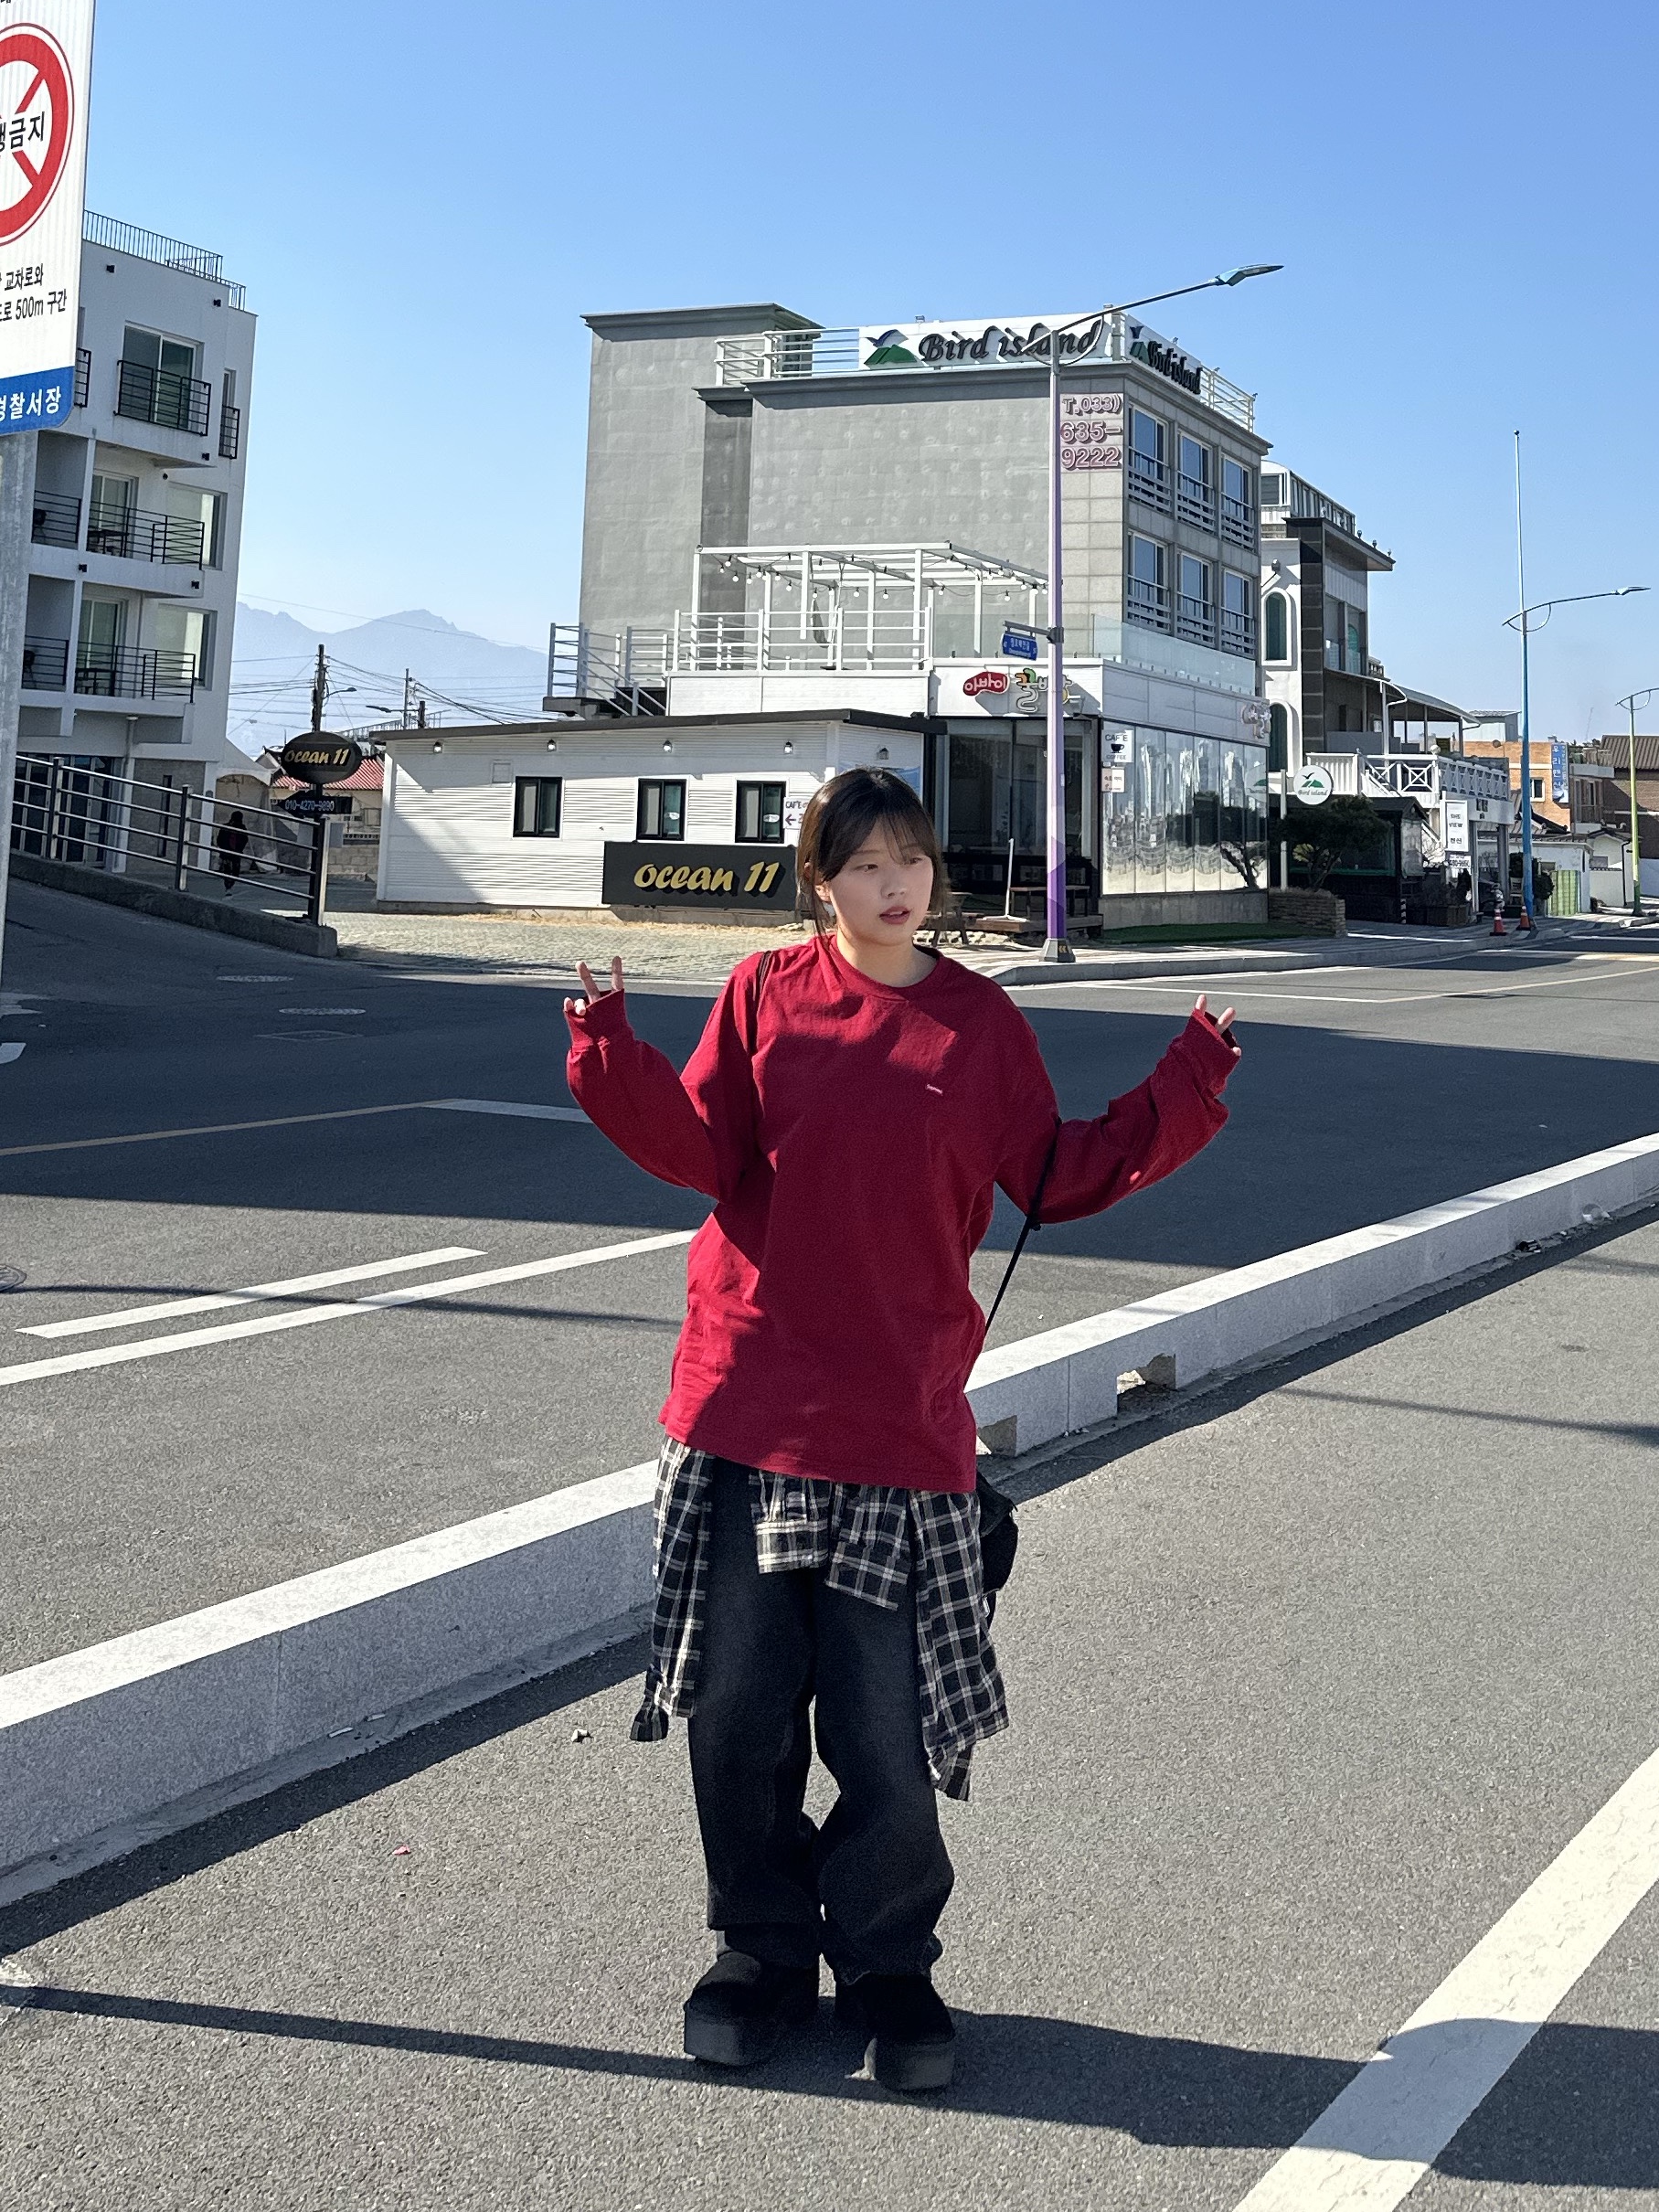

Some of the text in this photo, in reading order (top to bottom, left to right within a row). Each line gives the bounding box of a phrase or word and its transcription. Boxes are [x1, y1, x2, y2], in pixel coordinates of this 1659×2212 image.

[5, 263, 44, 291] 교차로와
[16, 296, 43, 320] 500m
[48, 289, 67, 314] 구간
[918, 319, 1103, 362] Bird island
[1148, 341, 1174, 377] Bird
[1062, 393, 1122, 415] T.033)
[1060, 420, 1122, 443] 635-
[1061, 446, 1121, 469] 9222
[963, 673, 1006, 692] 아바이
[333, 748, 350, 765] 11
[633, 861, 780, 892] ocean 11
